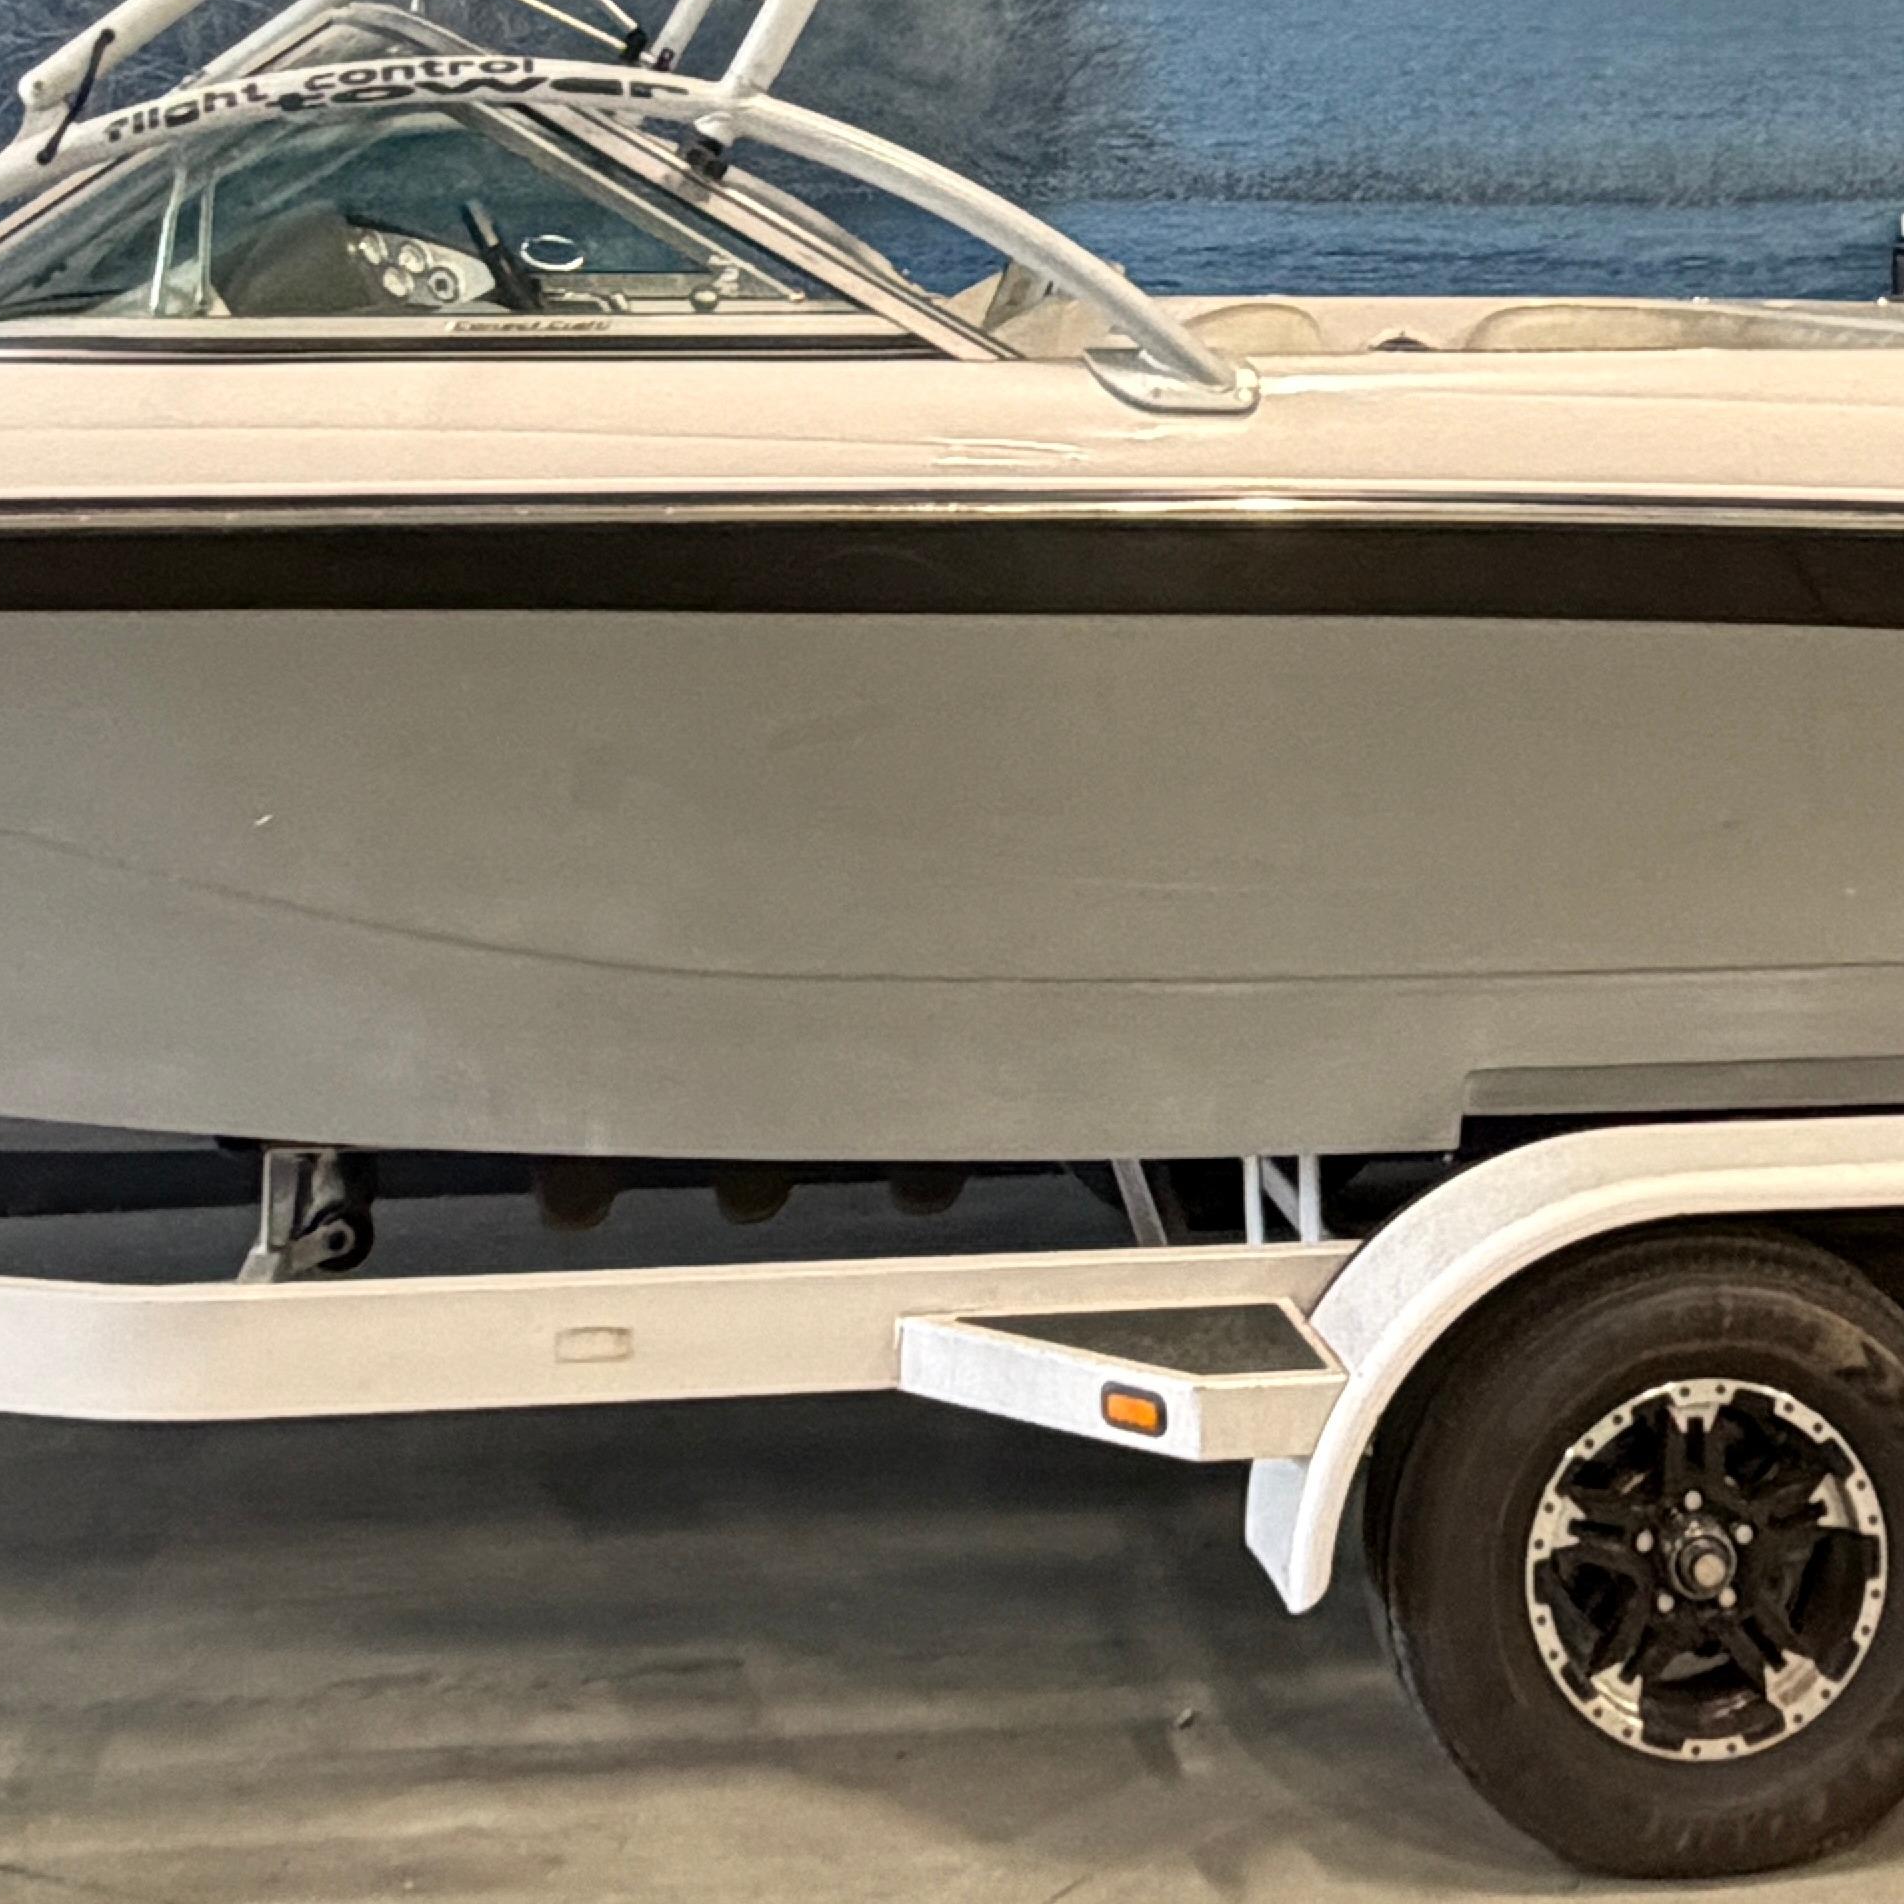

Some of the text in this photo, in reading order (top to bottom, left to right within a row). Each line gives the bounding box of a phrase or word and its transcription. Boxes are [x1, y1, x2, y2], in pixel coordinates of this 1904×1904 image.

[102, 56, 535, 143] flight control
[266, 76, 690, 112] tower
